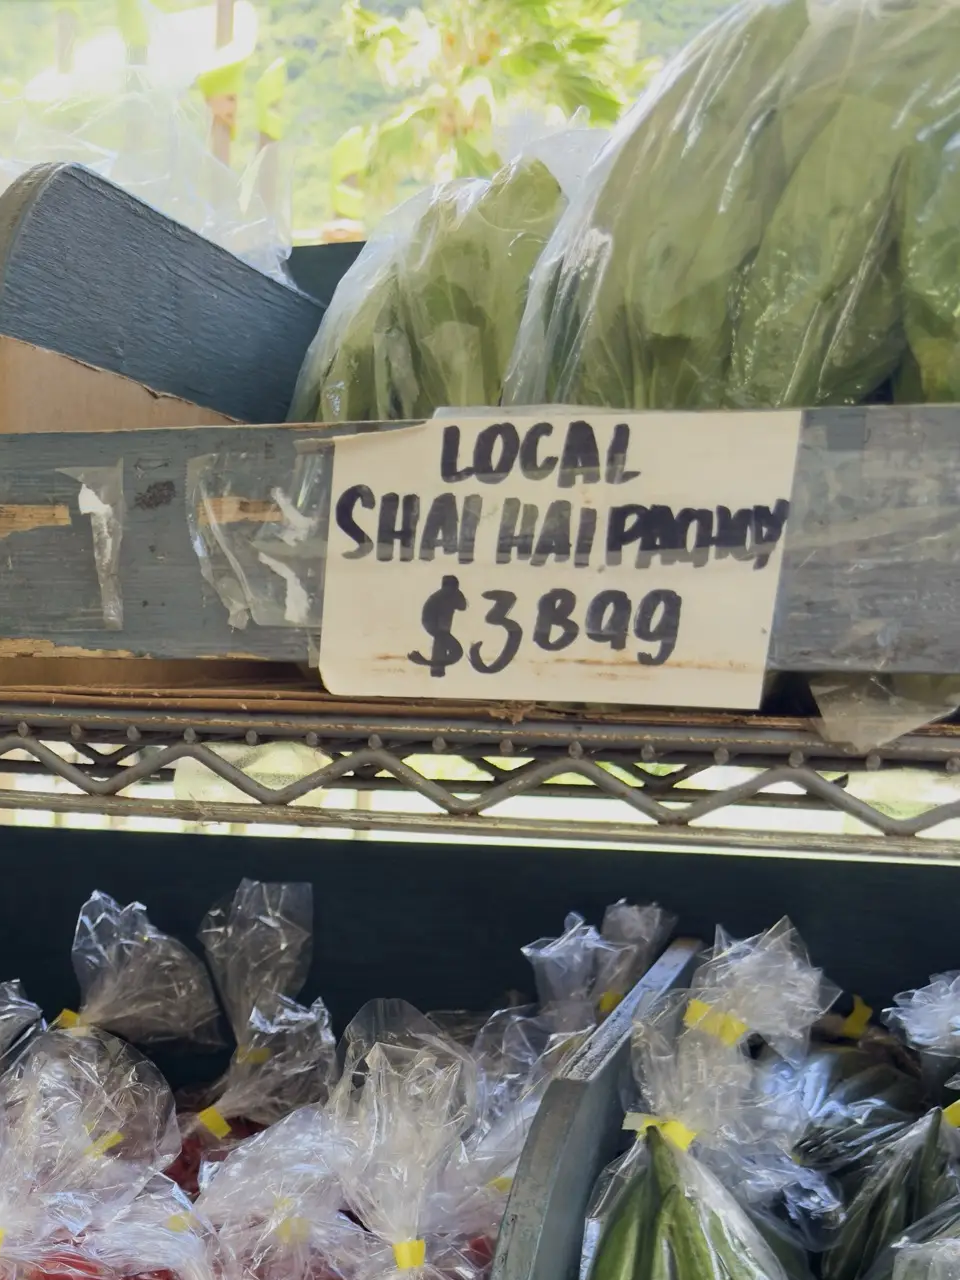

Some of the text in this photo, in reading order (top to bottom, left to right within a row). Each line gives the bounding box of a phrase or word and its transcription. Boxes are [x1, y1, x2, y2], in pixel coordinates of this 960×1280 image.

[440, 419, 642, 489] LOCAL
[335, 483, 482, 565] SHAI
[495, 497, 597, 568] HAI
[406, 574, 683, 678] $3 Bag
